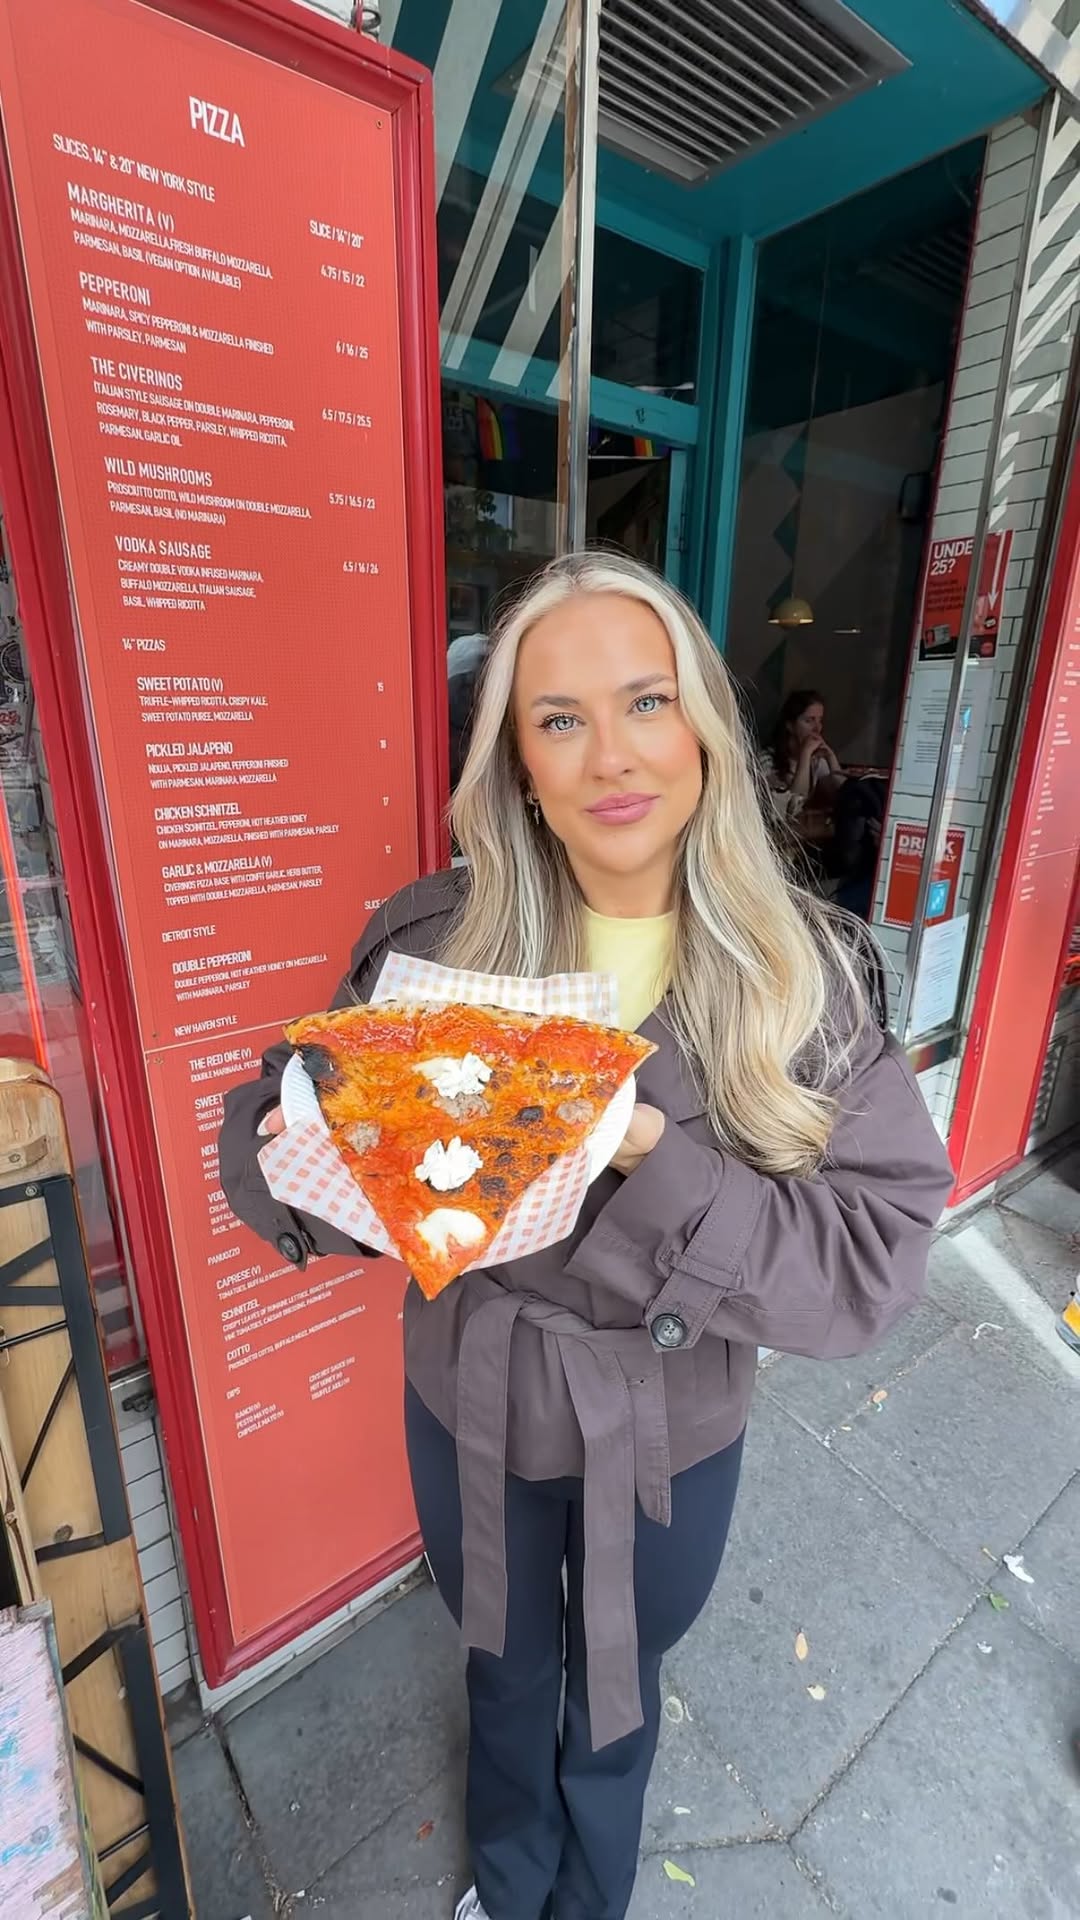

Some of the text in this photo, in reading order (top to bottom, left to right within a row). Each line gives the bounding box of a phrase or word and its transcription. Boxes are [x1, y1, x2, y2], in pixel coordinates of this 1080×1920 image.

[189, 96, 244, 148] PIZZA
[109, 152, 118, 170] &
[136, 162, 160, 184] NEW
[161, 170, 186, 193] YORK
[186, 179, 215, 203] STYLE
[67, 182, 175, 232] MARGHERITA (V)
[121, 245, 143, 262] BASIL
[145, 251, 174, 271] (VEGAN
[174, 260, 201, 278] OPTION
[201, 267, 241, 290] AVAILABLE)
[194, 246, 226, 266] BUFFALO
[79, 271, 151, 306] PEPPERONI
[86, 319, 108, 336] WITH
[144, 333, 186, 354] PARMESAN
[129, 310, 150, 326] SPICY
[151, 315, 192, 336] PEPPERONI
[192, 325, 198, 337] &
[199, 327, 244, 348] MOZZARELLA
[245, 338, 274, 355] FINISHED
[91, 357, 183, 391] THE CIVERINOS
[94, 382, 125, 398] ITALIAN
[124, 388, 148, 403] STYLE
[149, 393, 183, 409] SAUSAGE
[183, 400, 195, 412] ON
[194, 402, 220, 417] DOUBLE
[141, 410, 166, 425] BLACK
[229, 426, 259, 442] WHIPPED
[144, 430, 170, 444] GARLIC
[170, 434, 182, 446] OIL
[104, 457, 212, 487] WILD MUSHROOMS
[107, 482, 153, 498] PROSCIUTTO
[178, 491, 197, 503] WILD
[196, 494, 236, 508] MUSHROOM
[235, 499, 246, 510] ON
[245, 500, 269, 513] DOUBLE
[153, 506, 173, 518] BASIL
[174, 509, 187, 520] (NO
[187, 510, 226, 524] MARINARA)
[115, 536, 211, 559] VODKA SAUSAGE
[934, 539, 974, 559] UNDE
[118, 560, 149, 573] CREAMY
[149, 563, 176, 575] DOUBLE
[177, 565, 200, 577] VODKA
[200, 567, 228, 579] INFUSED
[930, 558, 956, 576] 25?
[120, 578, 153, 590] BUFFALO
[199, 584, 225, 595] ITALIAN
[146, 597, 178, 609] WHIPPED
[177, 599, 205, 611] RICOTTA
[136, 639, 166, 651] PIZZAS
[137, 677, 223, 690] SWEET POTATO (V)
[146, 742, 233, 757] PICKLED JALAPENO
[154, 803, 240, 821] CHICKEN SCHNITZEL
[899, 834, 954, 855] DRIK
[162, 855, 272, 879] GARLIC & MOZZARELLA (V)
[161, 925, 216, 943] DETROIT STYLE
[172, 950, 252, 974] DOUBLE PEPPERONI
[174, 1015, 237, 1037] NEW HAVEN STYLE
[189, 1047, 252, 1071] THE RED ONE (V)
[195, 1093, 223, 1110] SWEET
[216, 1264, 261, 1290] CAPRESE (V)
[221, 1298, 259, 1322] SCHNITZEL
[227, 1343, 250, 1361] COTTO
